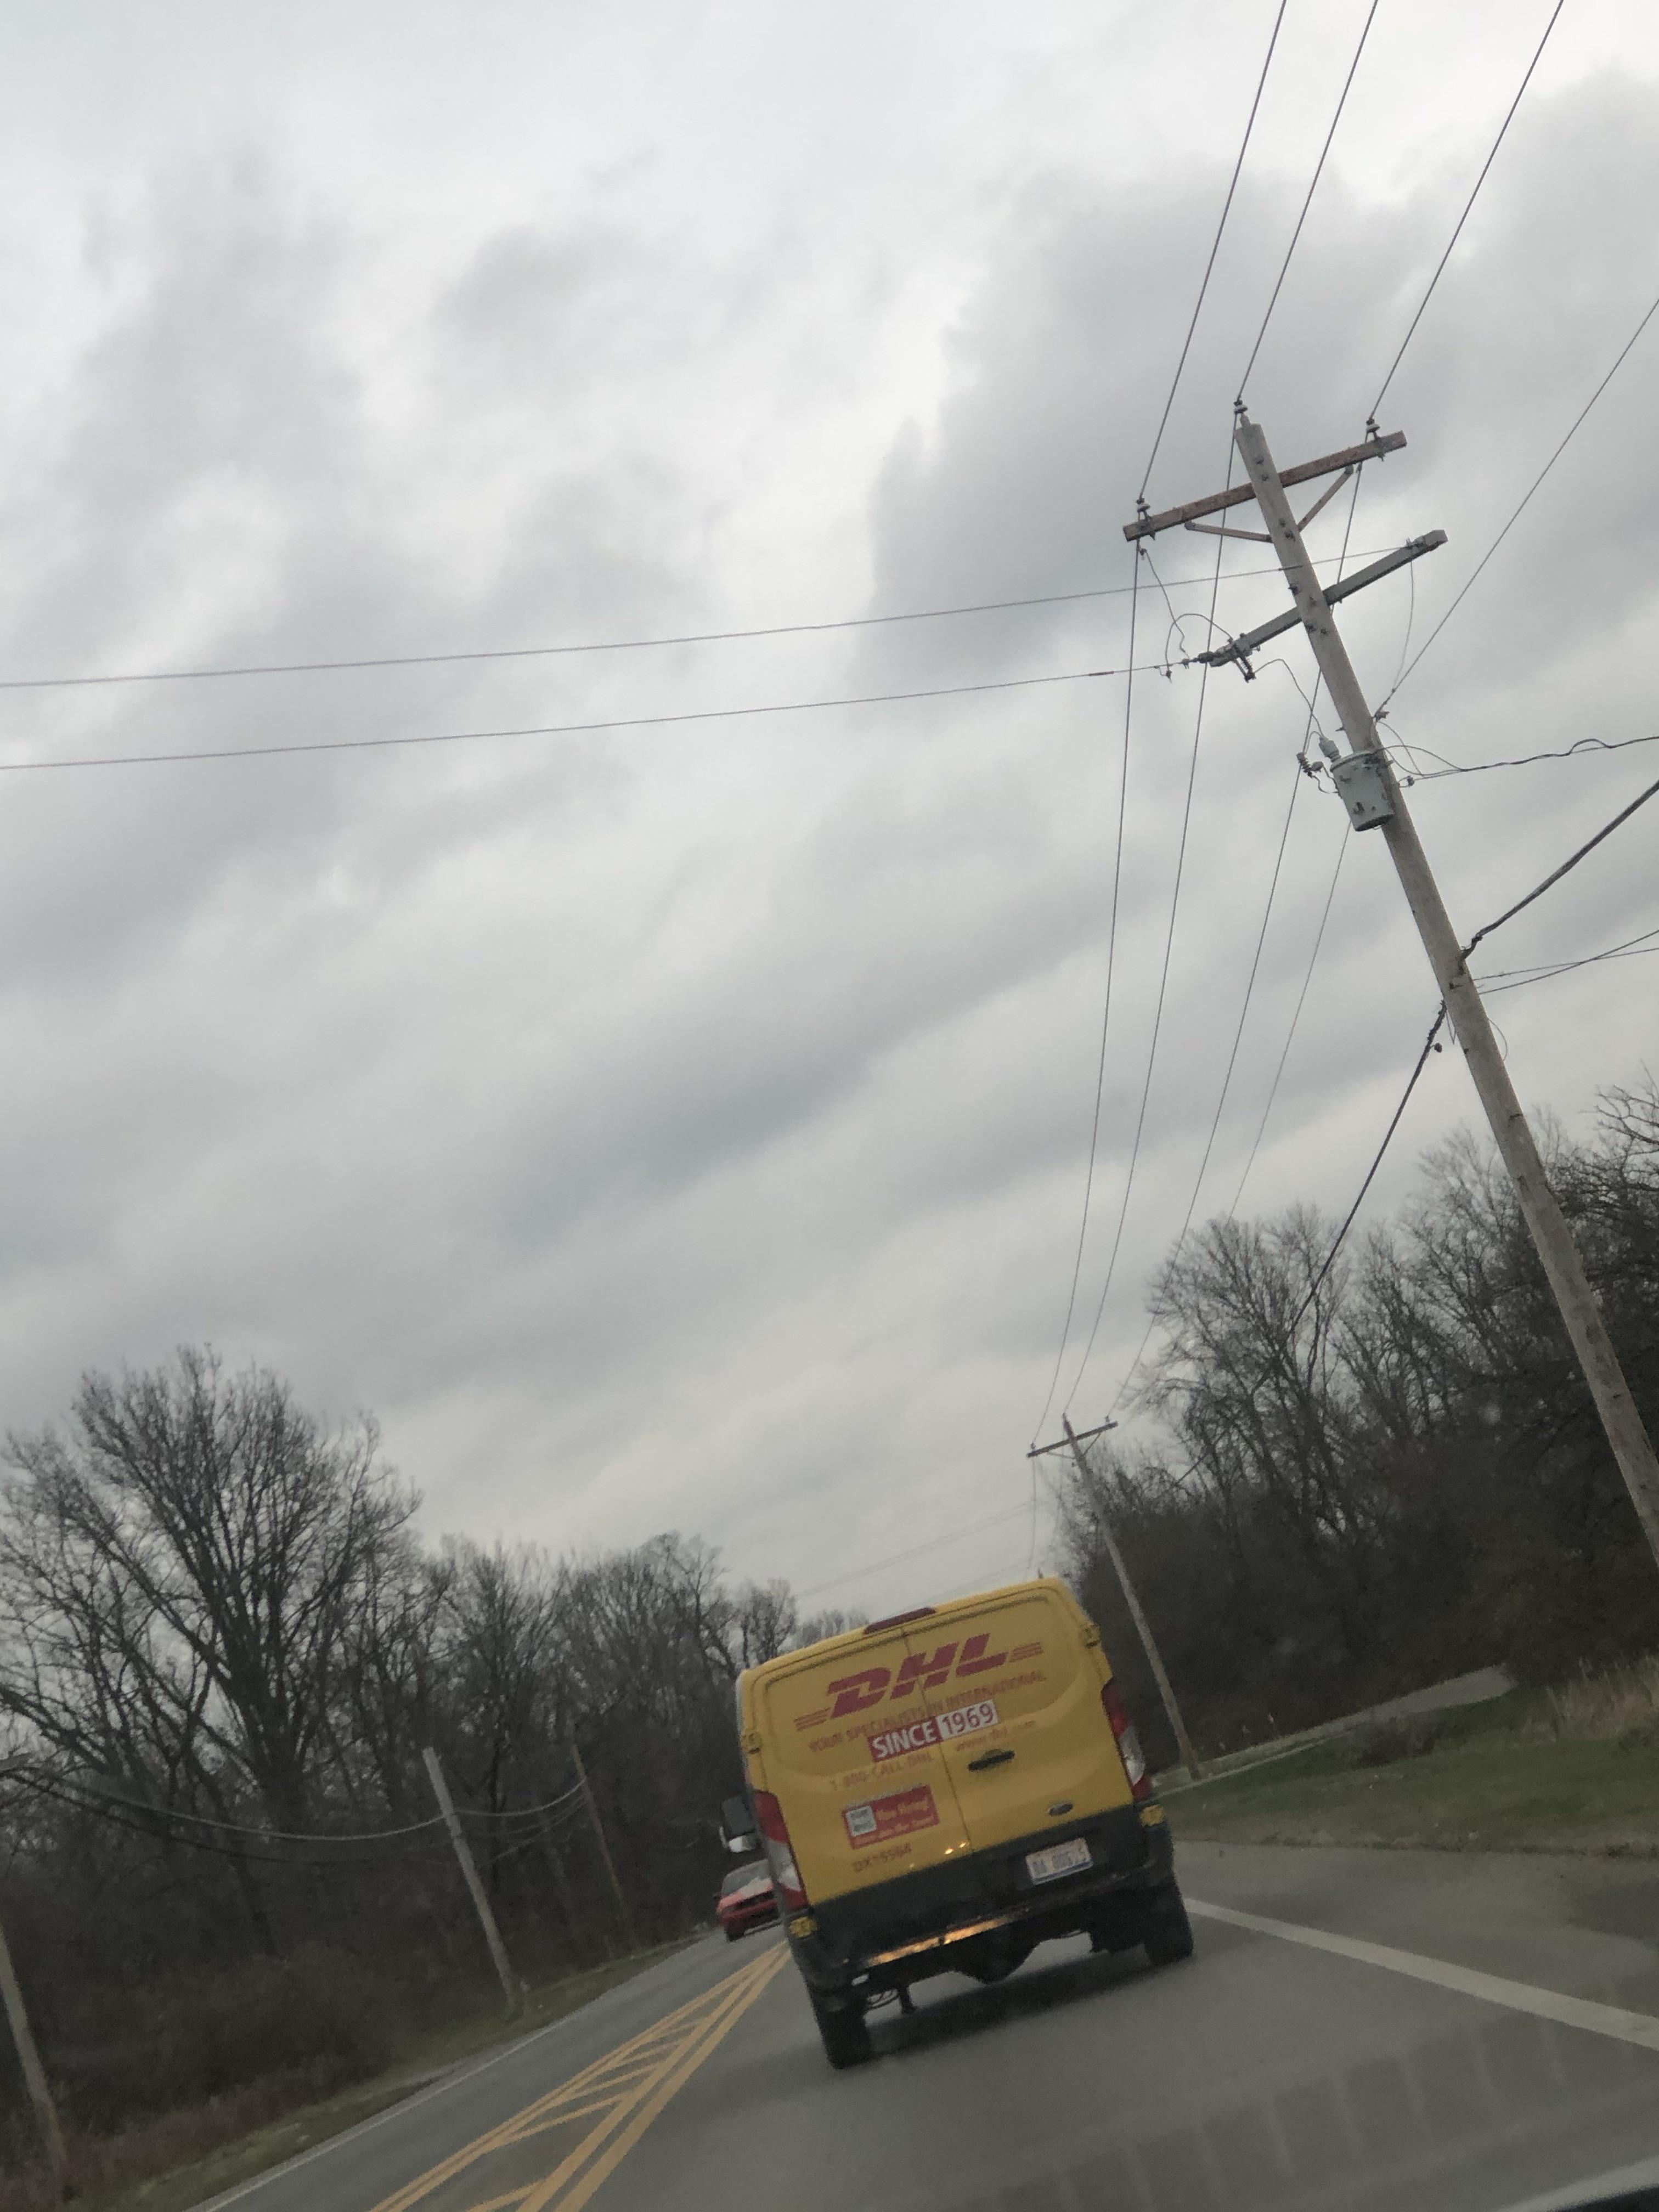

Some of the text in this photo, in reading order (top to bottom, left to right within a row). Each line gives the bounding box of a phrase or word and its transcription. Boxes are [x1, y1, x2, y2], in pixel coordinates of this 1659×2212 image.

[828, 1633, 1008, 1719] DHL
[872, 1720, 938, 1758] SINCE
[942, 1703, 994, 1735] 1969
